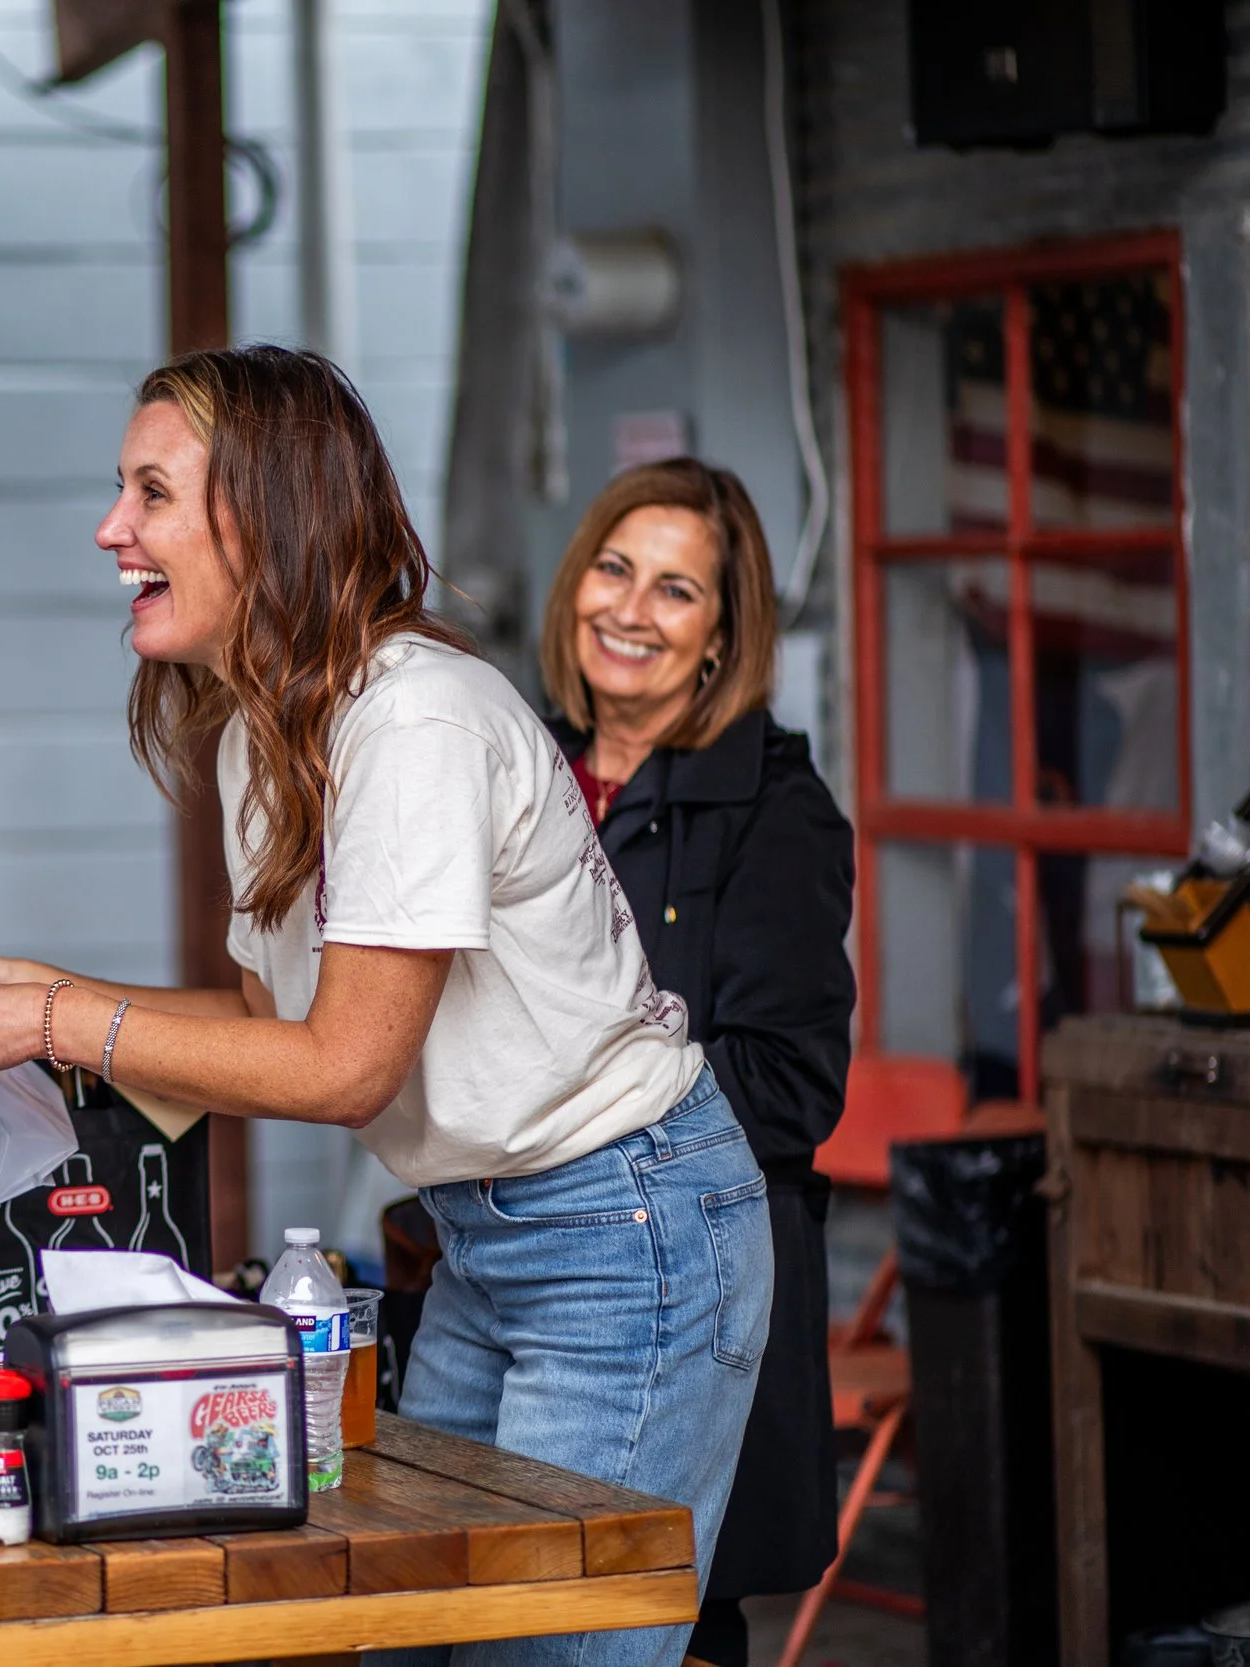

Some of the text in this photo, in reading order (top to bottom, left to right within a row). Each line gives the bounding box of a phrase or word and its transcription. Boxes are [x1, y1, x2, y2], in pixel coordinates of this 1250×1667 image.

[191, 1390, 261, 1440] GEARS
[221, 1401, 278, 1427] BEERS
[87, 1429, 153, 1443] SATURDAY
[93, 1444, 149, 1456] OCT 25th
[95, 1464, 119, 1481] 9a
[137, 1462, 161, 1481] 2p
[86, 1490, 121, 1500] Register
